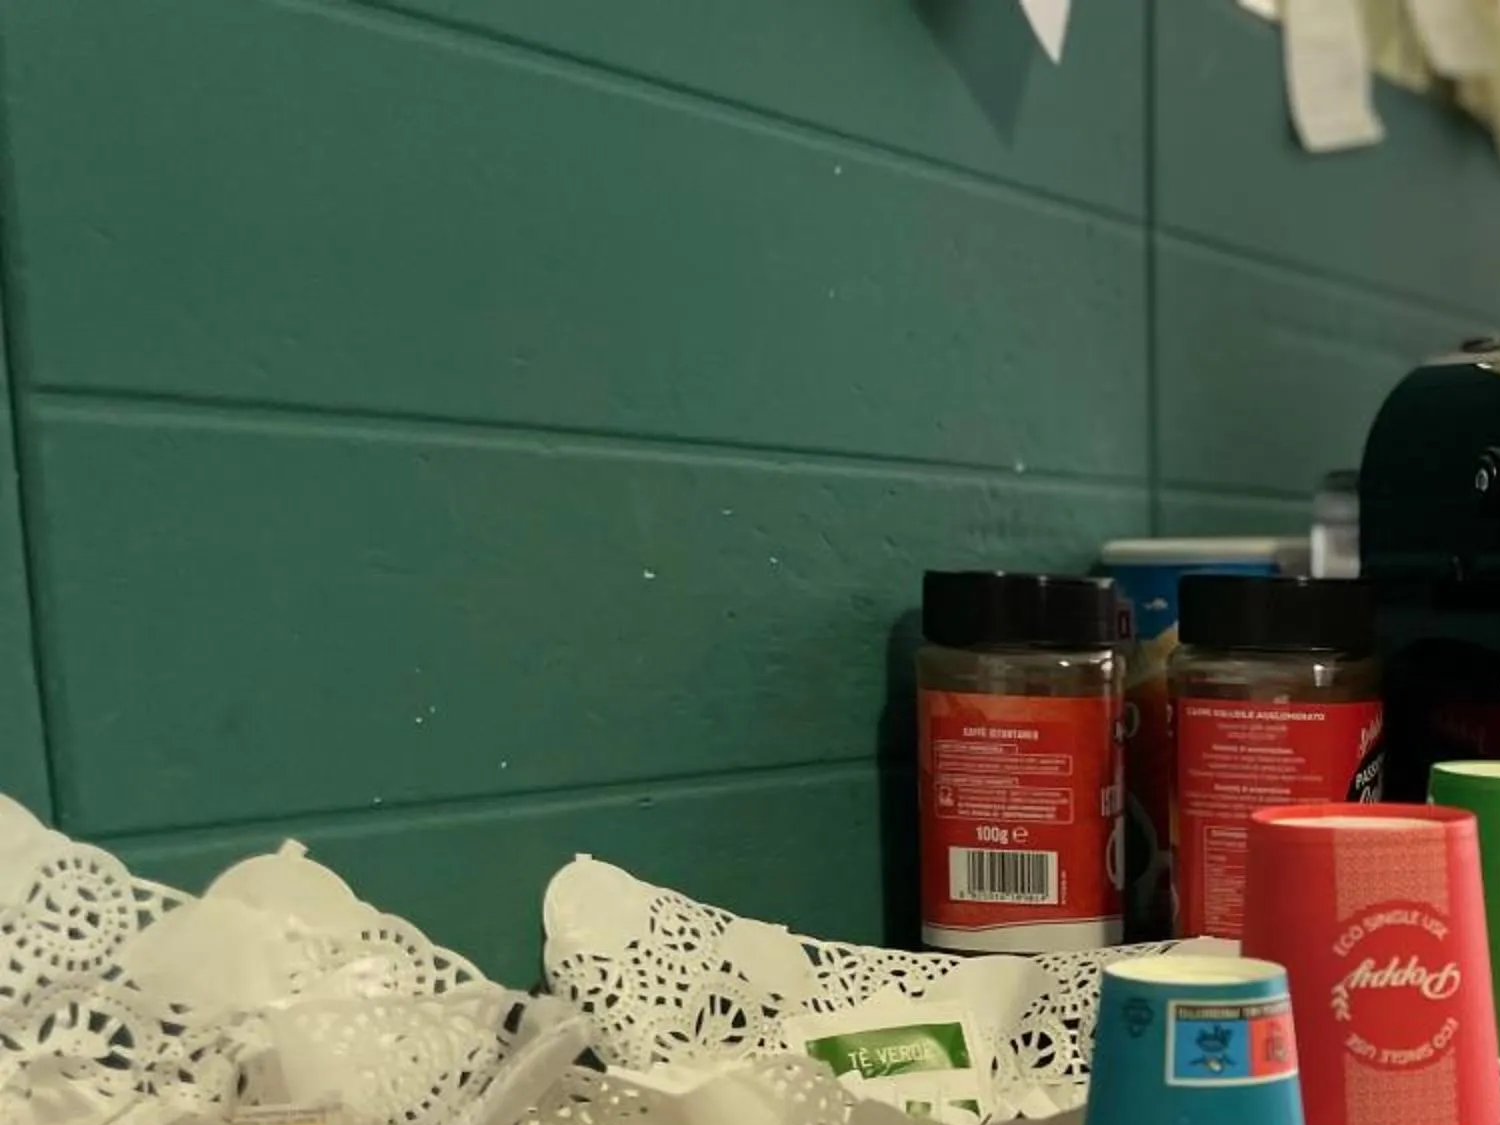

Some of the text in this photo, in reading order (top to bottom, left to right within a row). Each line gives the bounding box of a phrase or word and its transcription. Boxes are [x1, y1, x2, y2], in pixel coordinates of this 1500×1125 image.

[975, 825, 1009, 845] 100g
[1332, 909, 1449, 957] ECO SINGLE USE
[1345, 955, 1462, 1000] Poppy
[876, 1038, 936, 1064] VERDE
